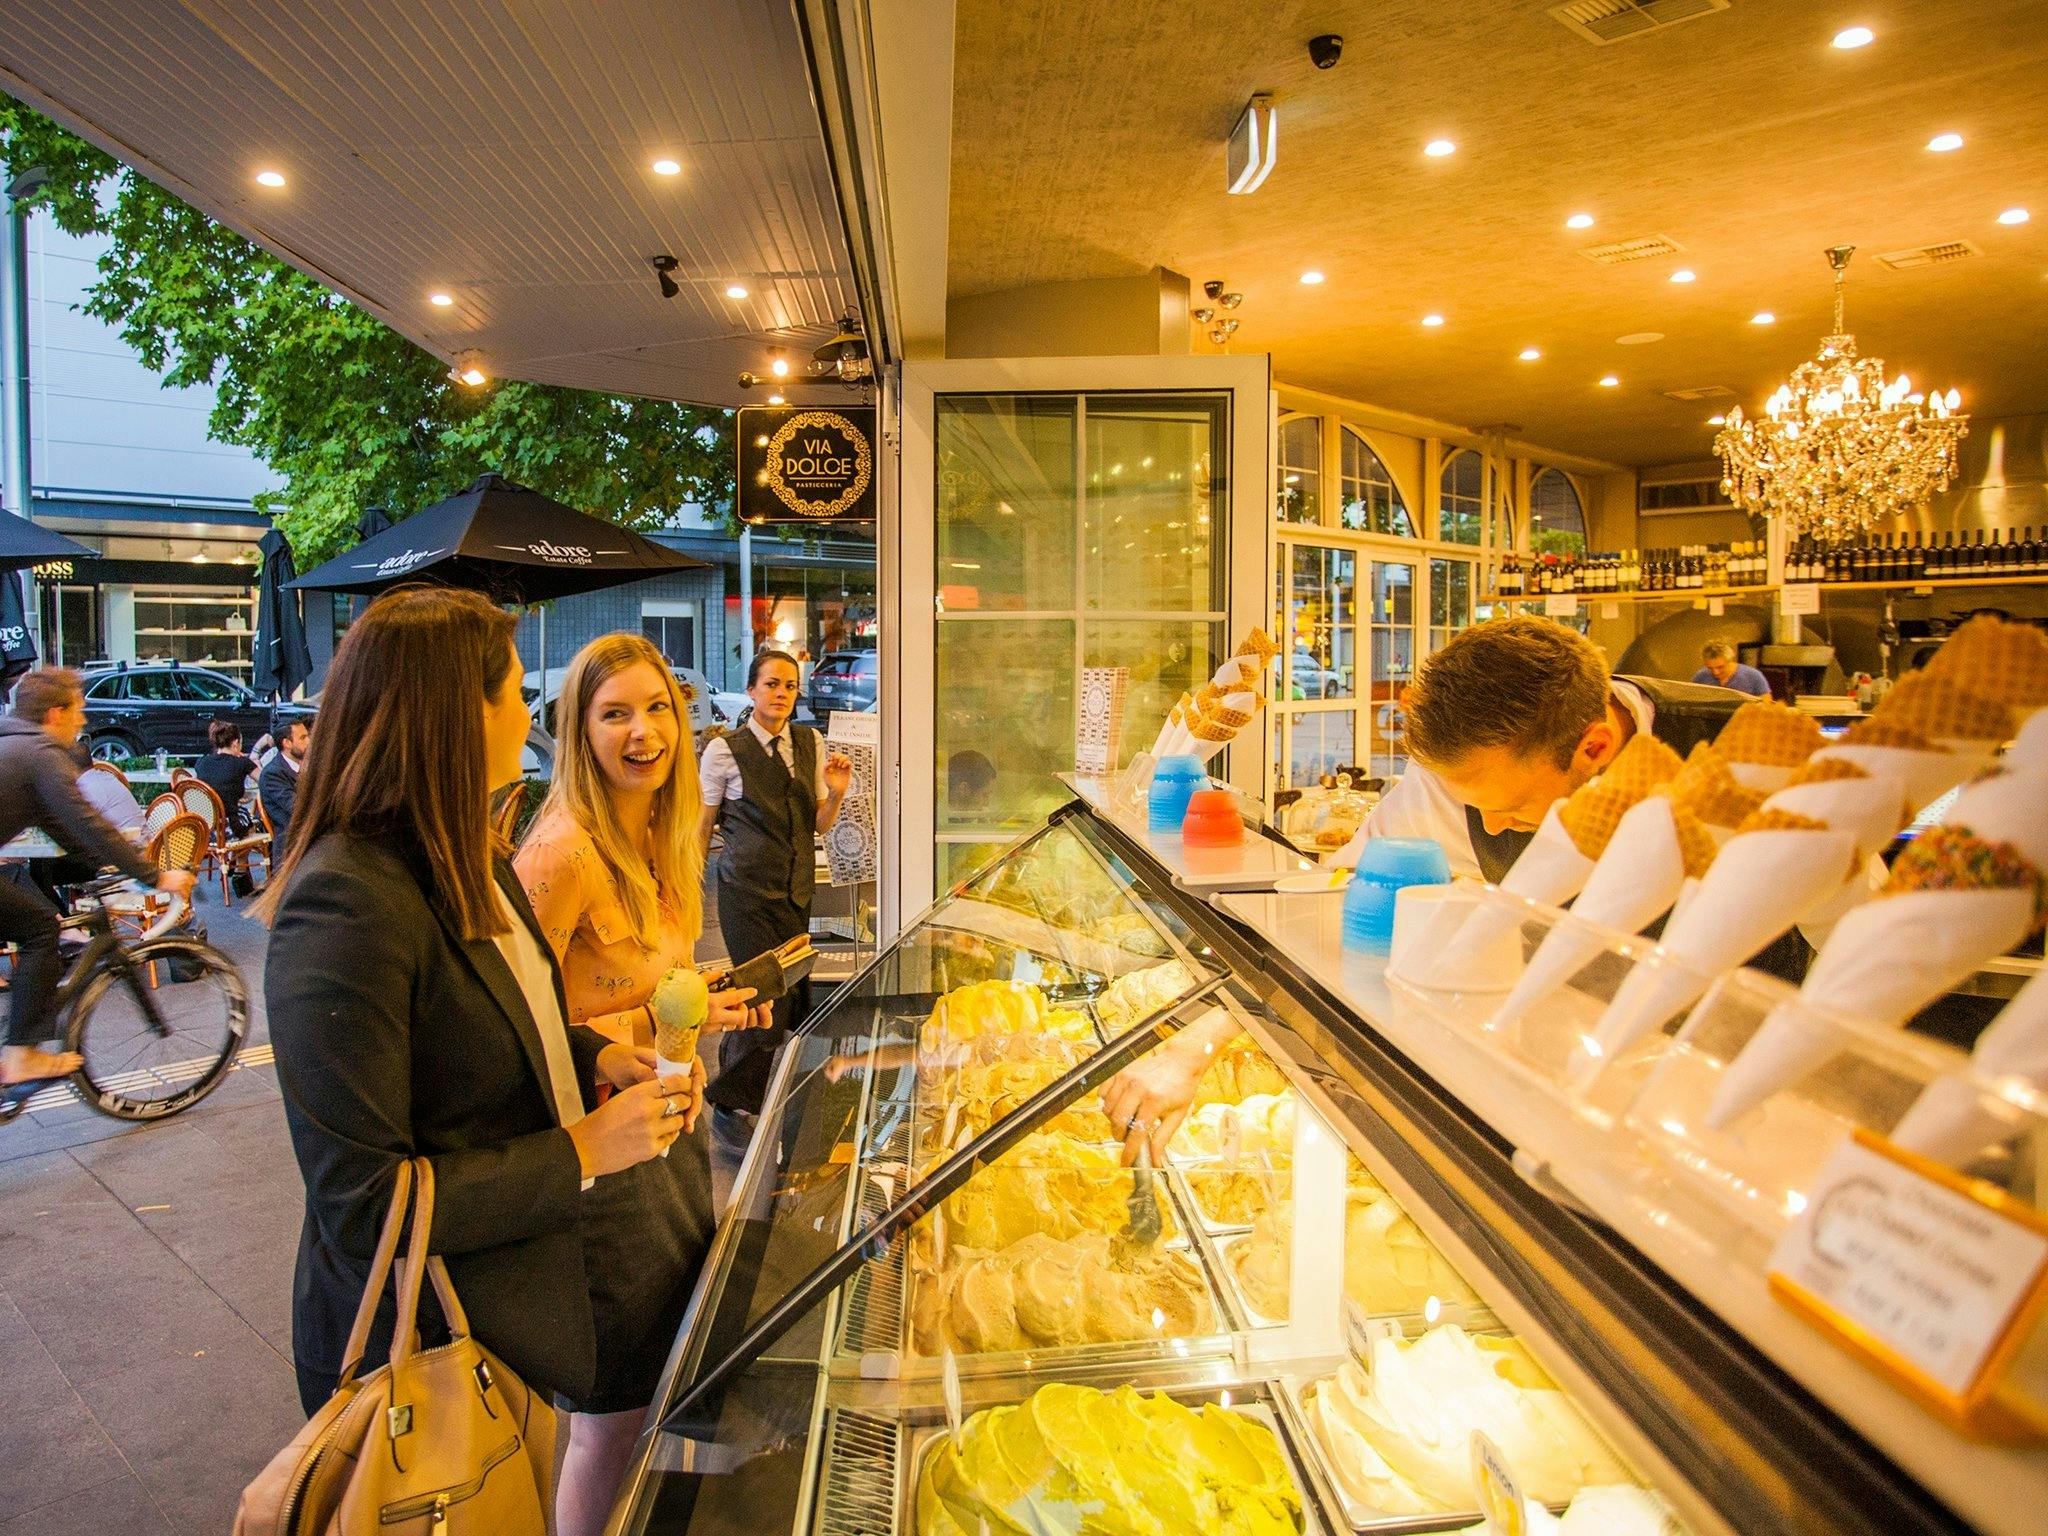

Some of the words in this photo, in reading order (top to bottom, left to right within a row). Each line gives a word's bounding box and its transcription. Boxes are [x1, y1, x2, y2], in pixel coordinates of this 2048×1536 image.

[803, 438, 833, 455] VIA
[786, 457, 852, 475] DOLCE
[528, 539, 591, 557] adore
[378, 549, 429, 570] adore
[568, 556, 592, 566] Coffee
[1482, 1443, 1515, 1498] Lemon
